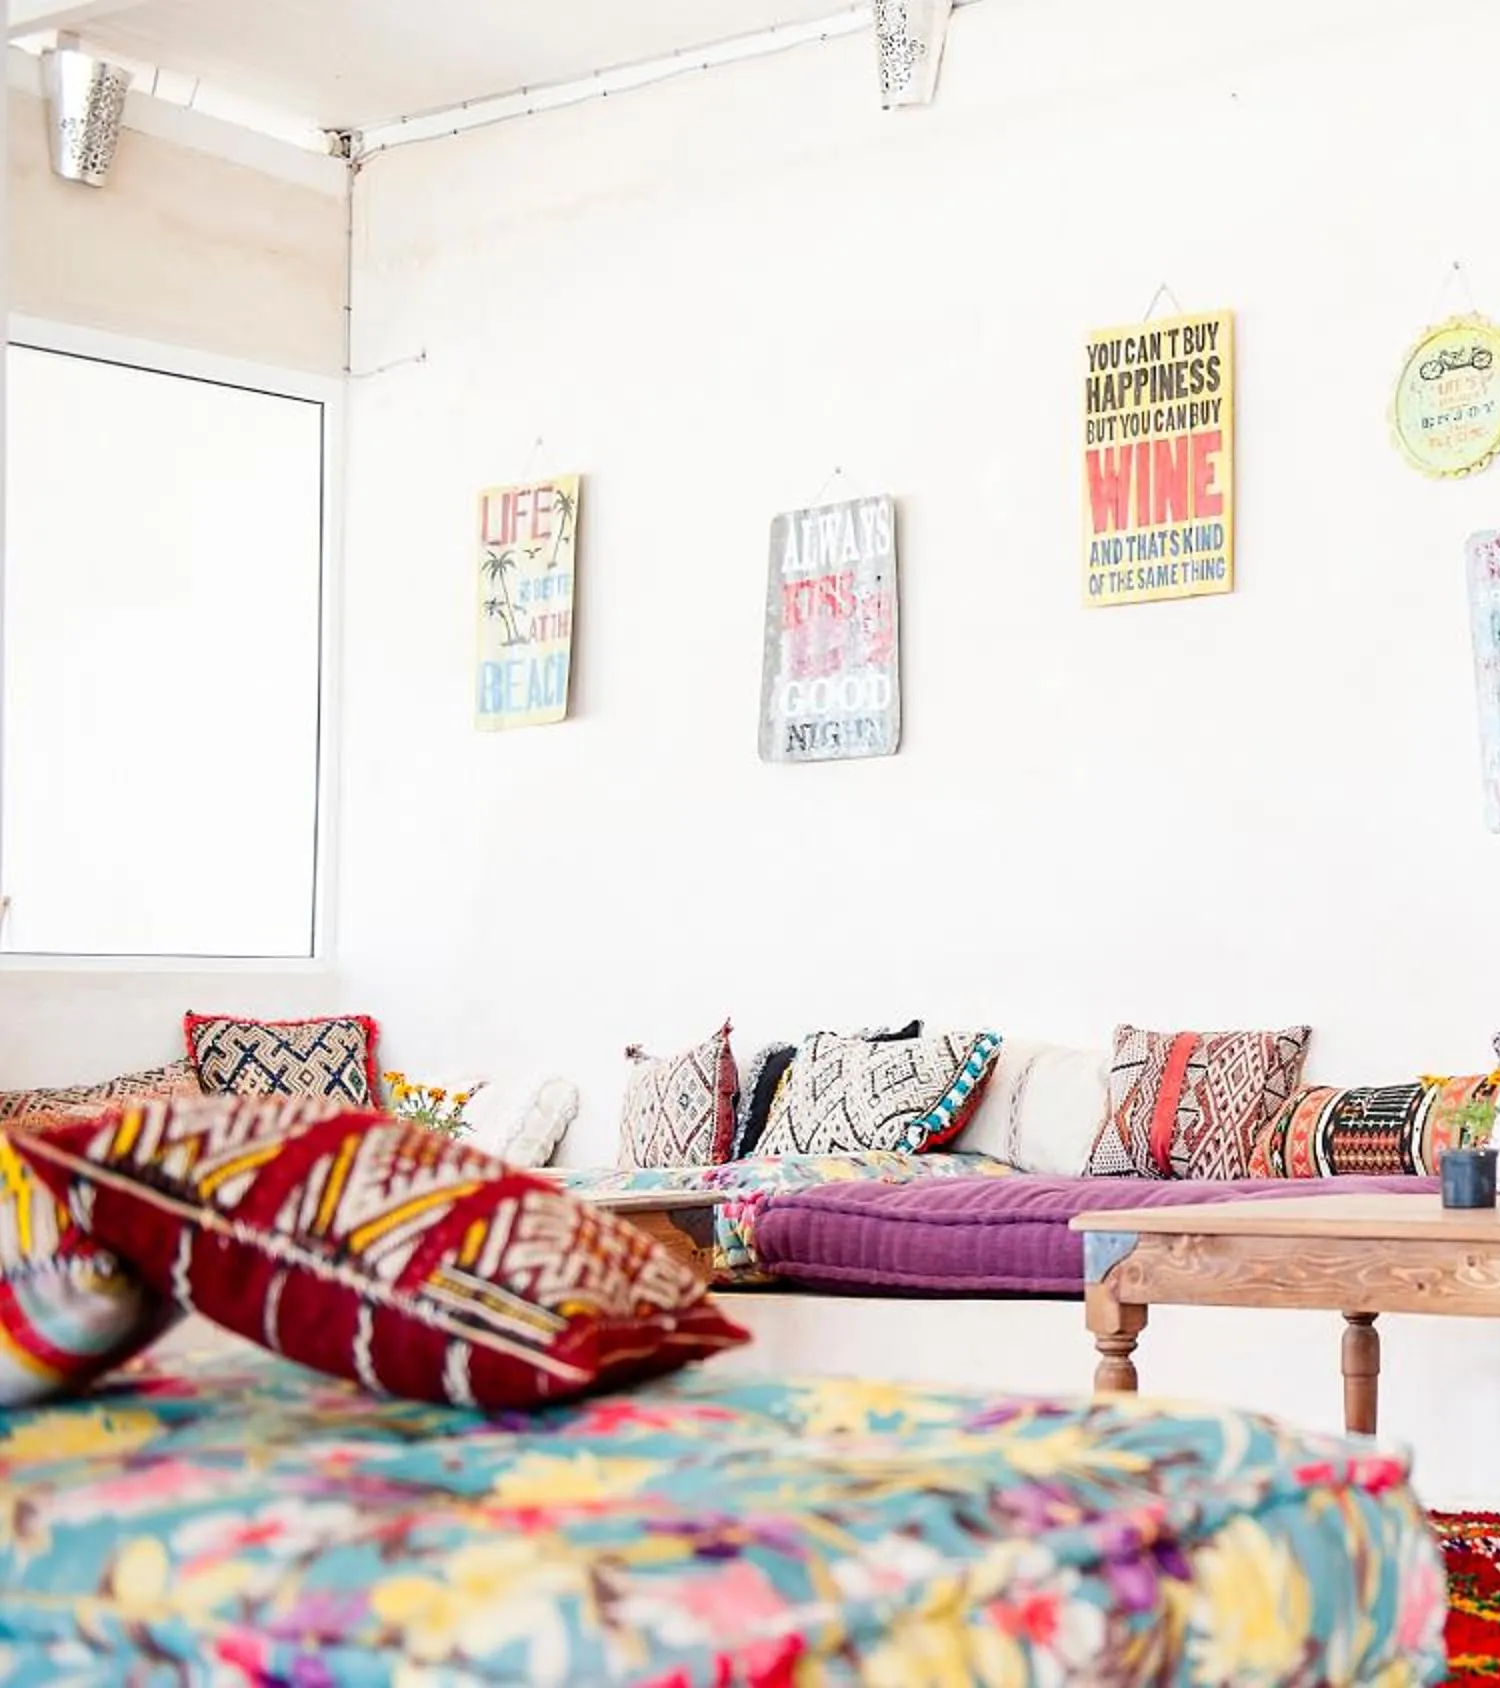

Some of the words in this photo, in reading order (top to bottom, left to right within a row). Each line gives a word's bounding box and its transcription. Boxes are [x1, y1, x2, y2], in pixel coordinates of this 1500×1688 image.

[1086, 340, 1121, 373] YOU
[1125, 328, 1180, 365] CAN'T
[1183, 321, 1220, 355] BUY
[1085, 355, 1221, 414] HAPPINESS
[1087, 415, 1117, 445] BUT
[1119, 409, 1151, 440] YOU
[1153, 404, 1187, 434] CAN
[1189, 397, 1222, 428] BUY
[1085, 429, 1224, 535] WINE
[482, 485, 555, 546] LIFE
[781, 501, 891, 574] ALWAYS
[1089, 535, 1123, 568] AND
[1183, 522, 1224, 555] KIND
[1088, 573, 1107, 596] OF
[1109, 569, 1135, 594] THE
[1137, 562, 1179, 590] SAME
[1181, 556, 1226, 583] THING
[529, 613, 549, 643] AT
[551, 609, 571, 640] TH
[779, 673, 891, 717] GOOD
